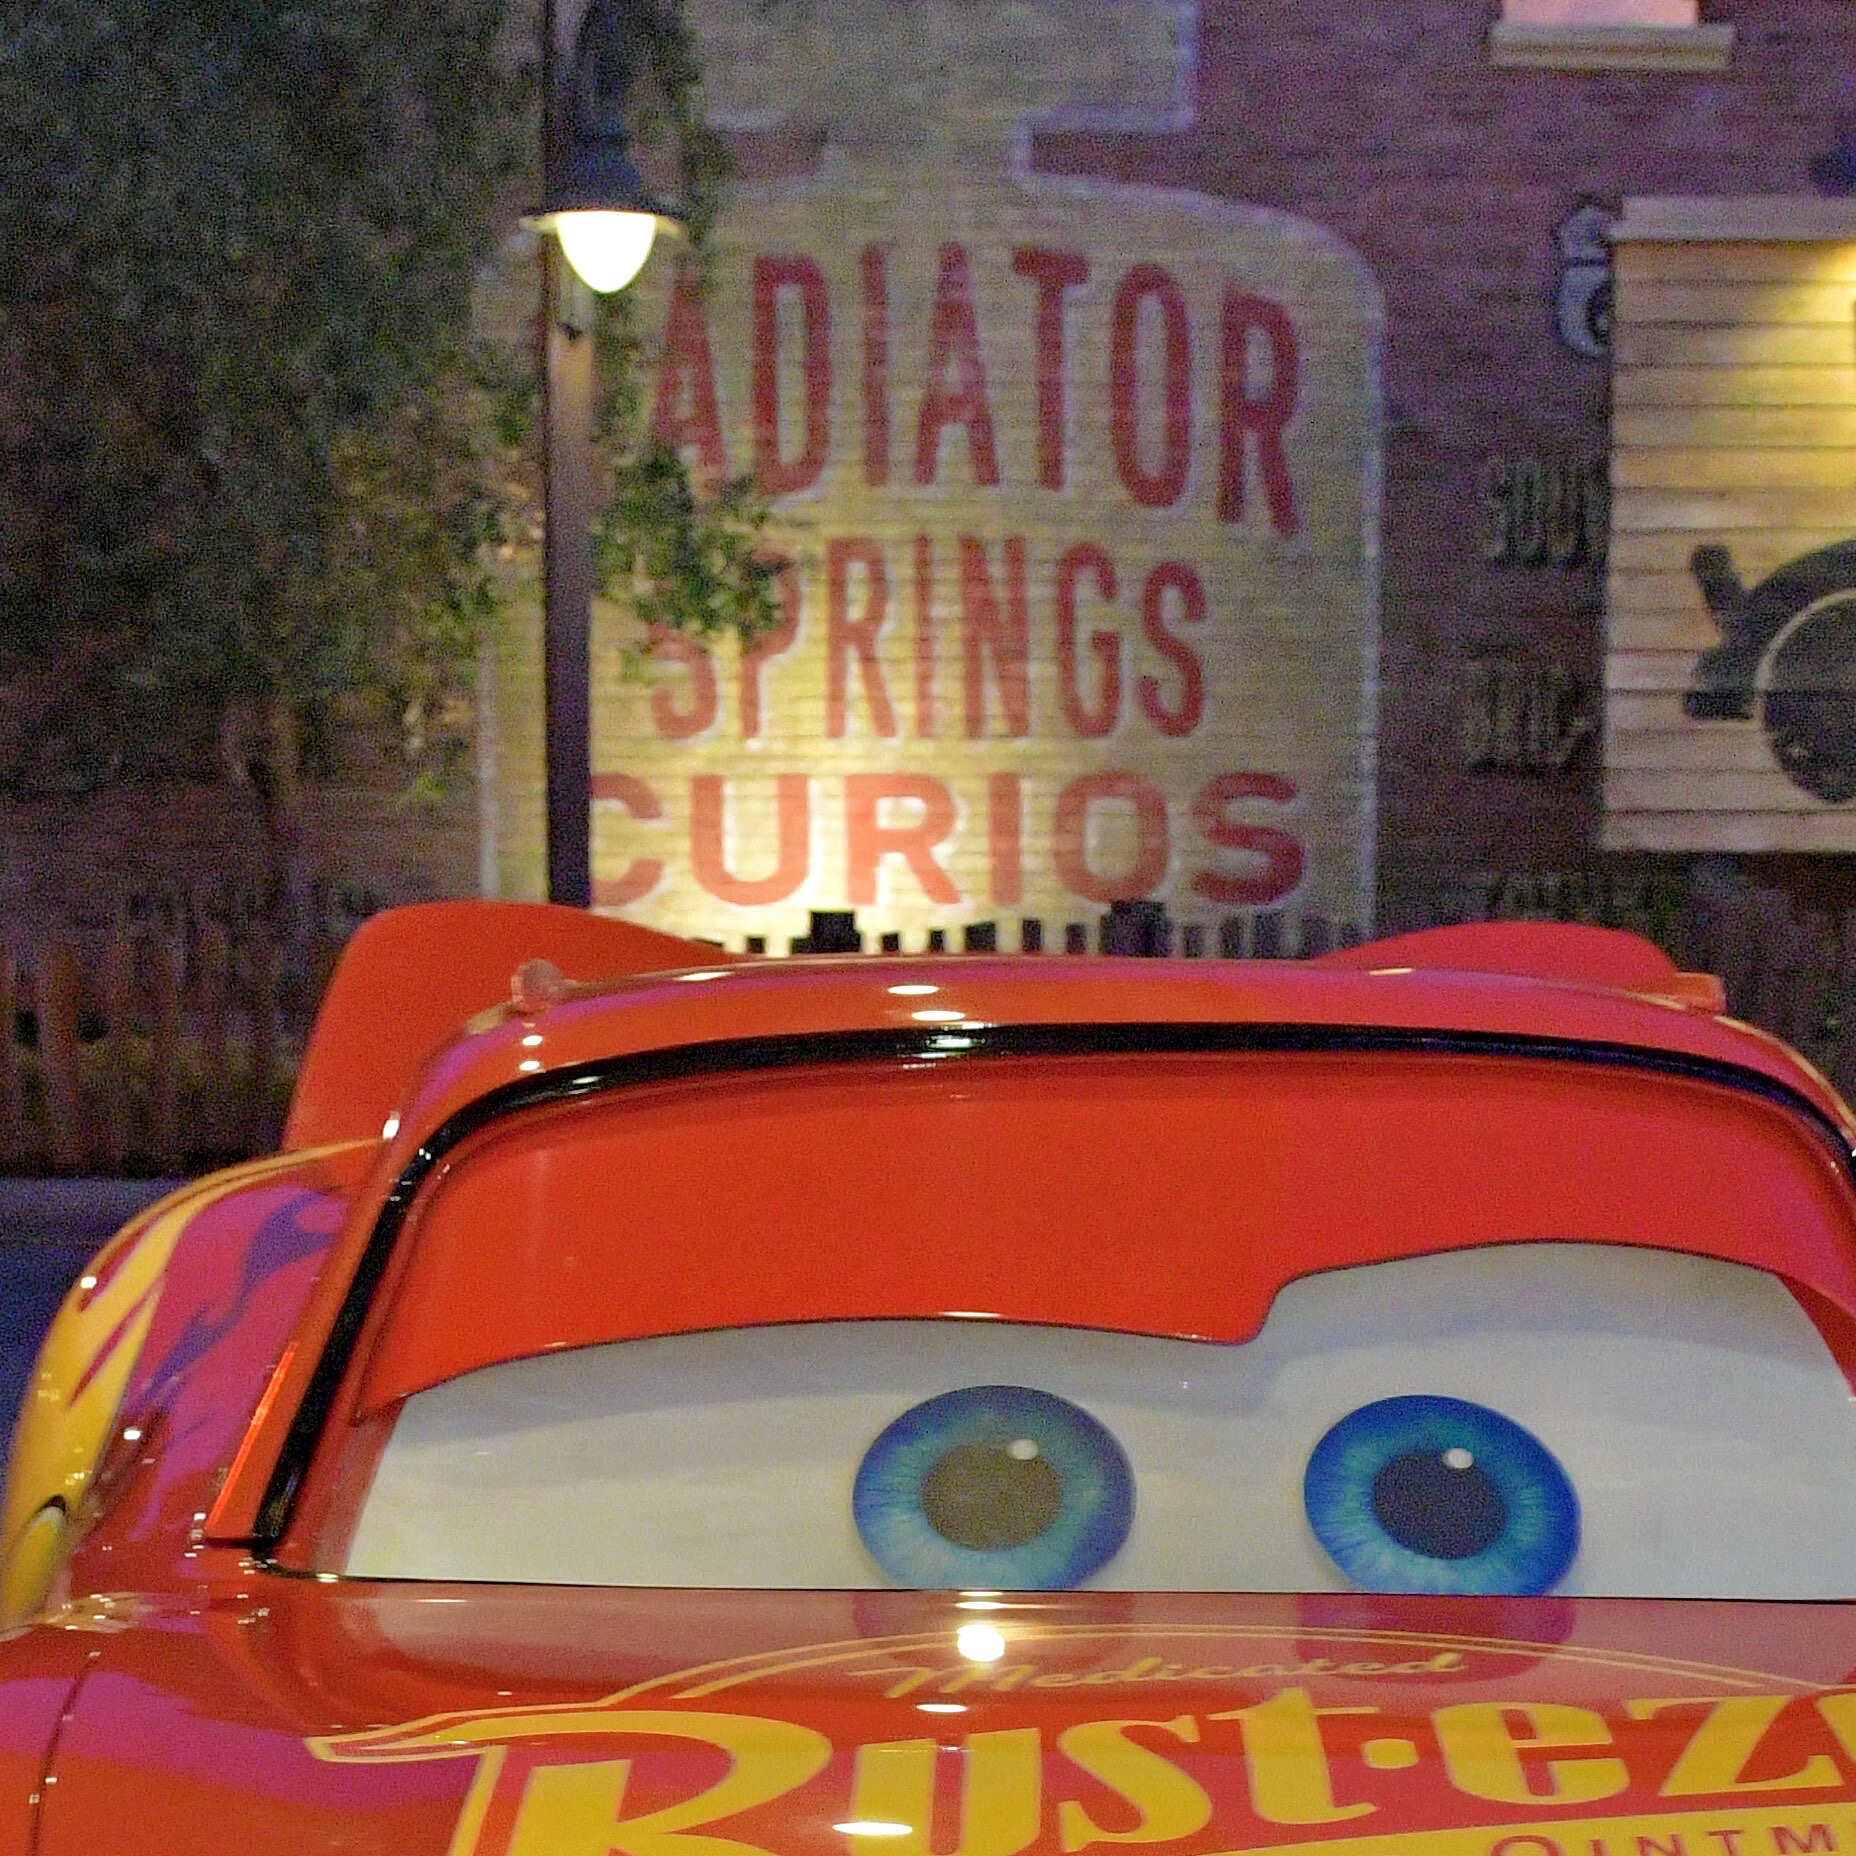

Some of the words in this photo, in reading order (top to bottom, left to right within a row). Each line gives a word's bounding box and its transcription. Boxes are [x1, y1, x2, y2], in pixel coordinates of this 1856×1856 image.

[652, 240, 1302, 538] ADIATOR
[589, 769, 1307, 907] CURIOS
[846, 1652, 1469, 1700] Medicated
